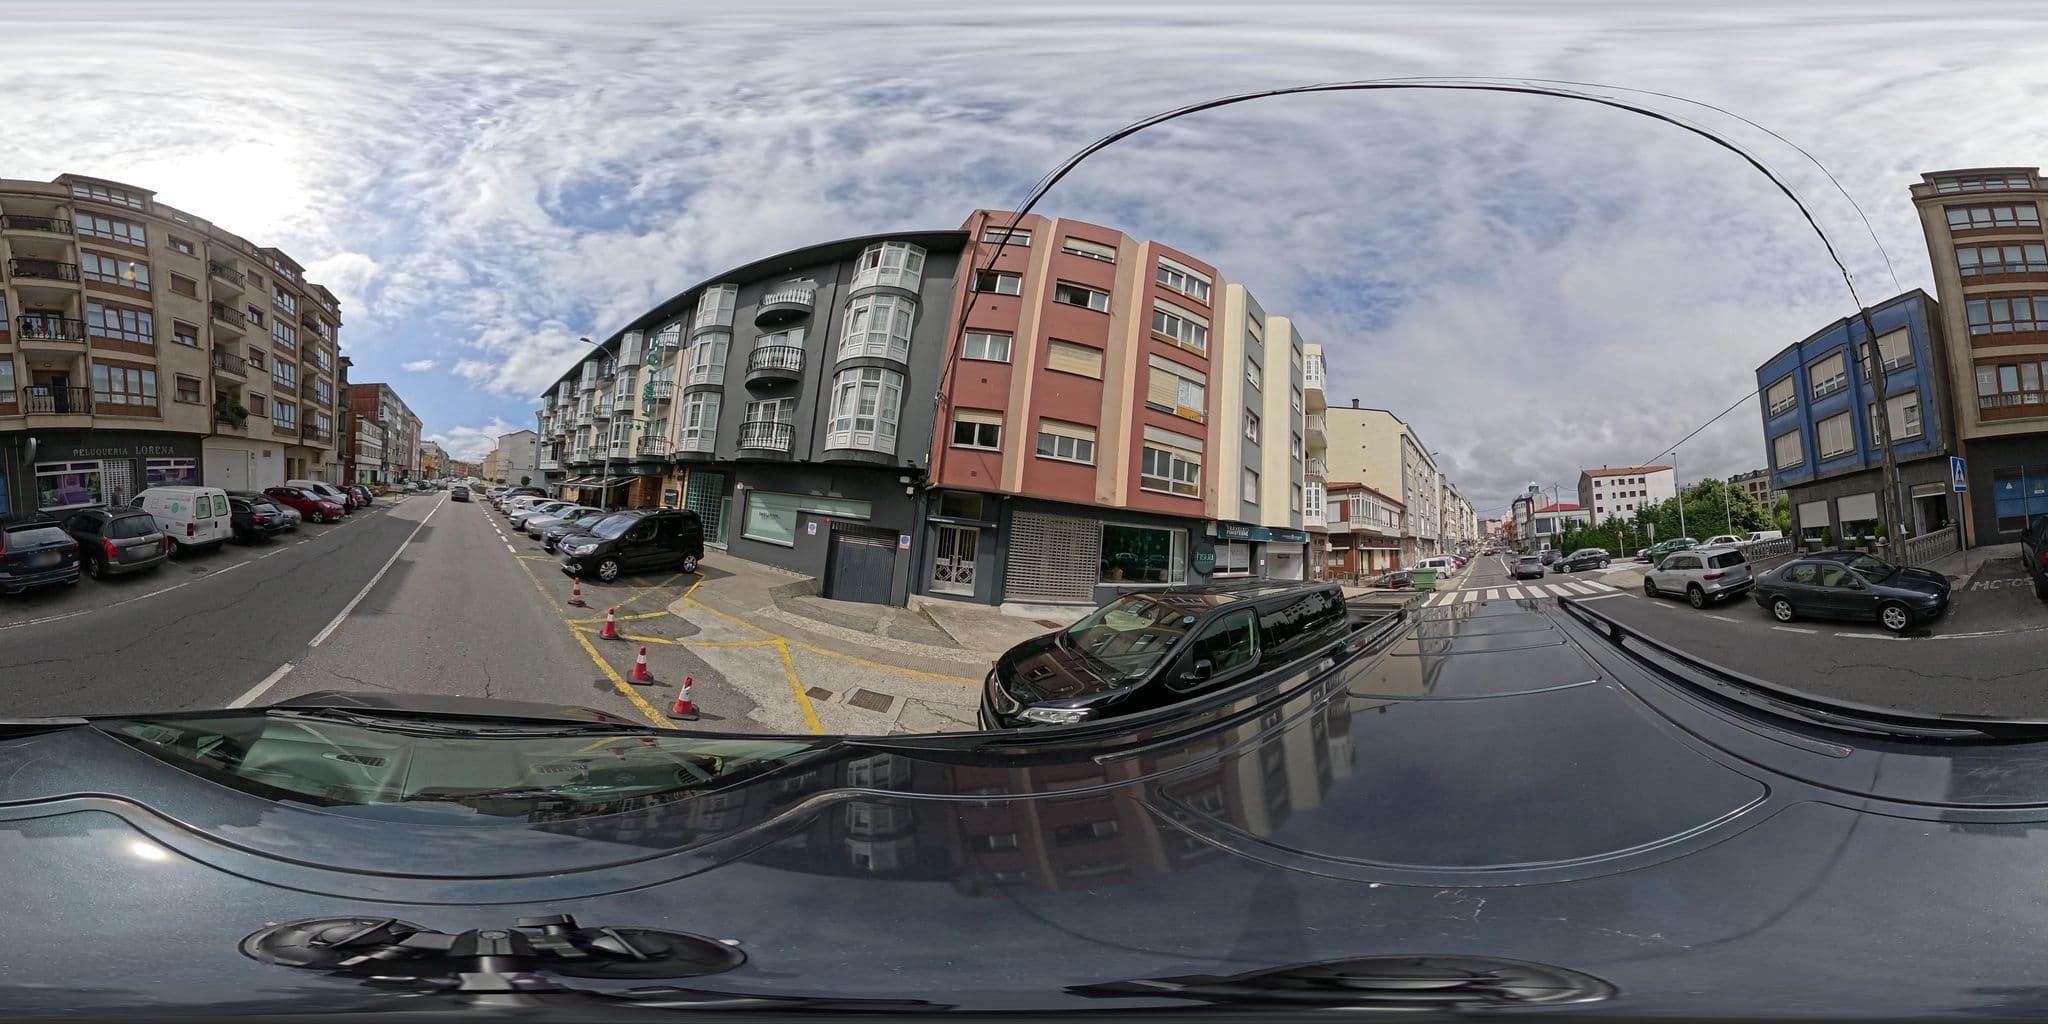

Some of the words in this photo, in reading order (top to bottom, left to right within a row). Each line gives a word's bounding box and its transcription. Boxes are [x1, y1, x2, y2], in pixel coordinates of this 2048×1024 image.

[642, 337, 660, 417] HOTEL
[73, 448, 128, 457] PELUQUERIA
[135, 445, 175, 455] LORENA
